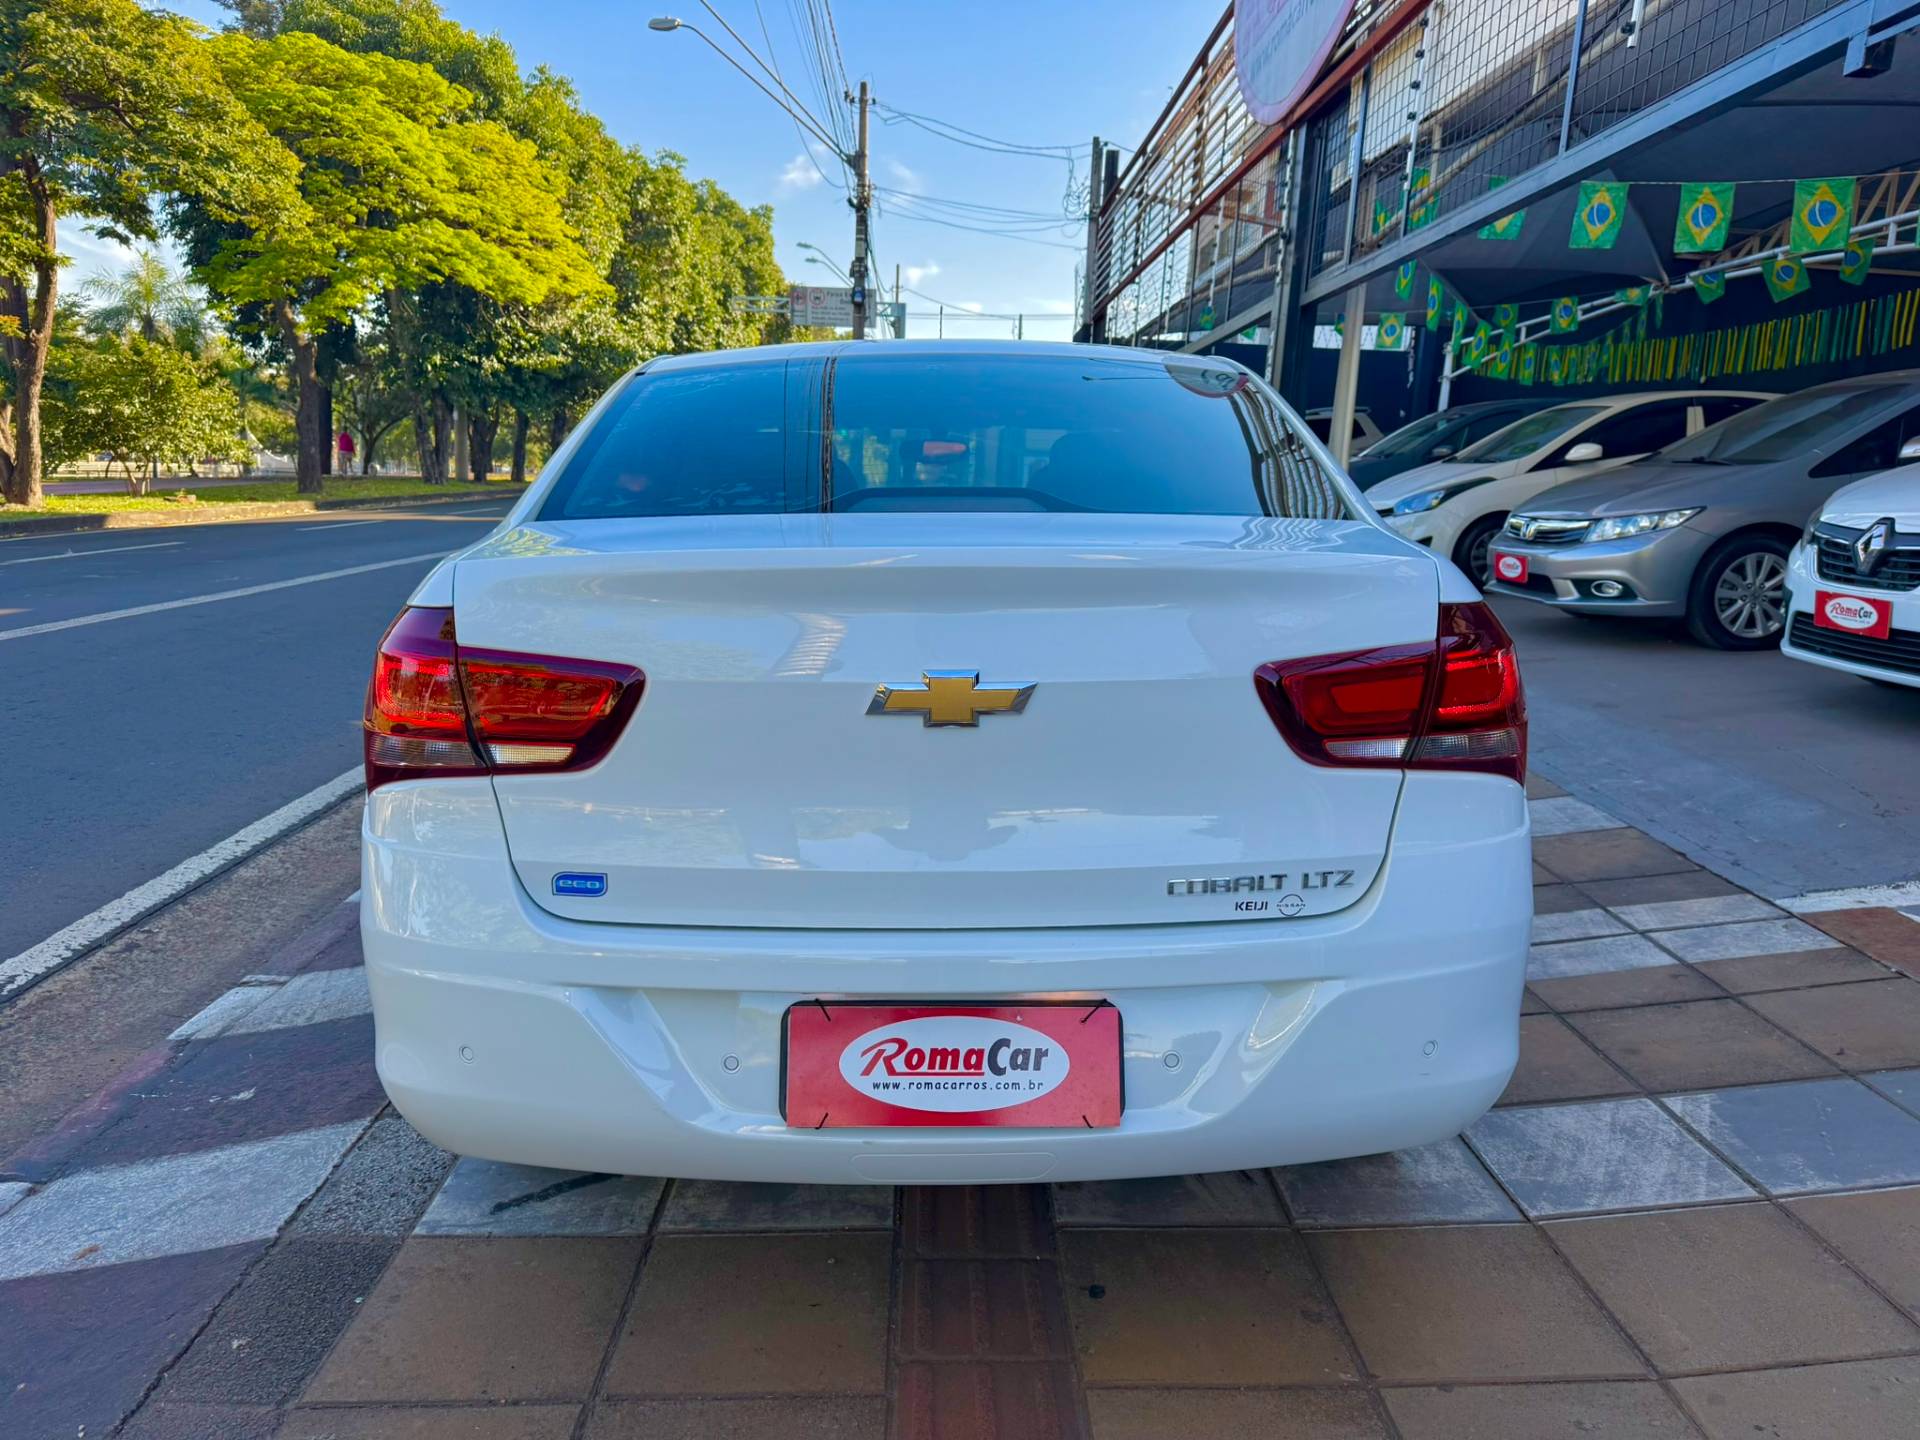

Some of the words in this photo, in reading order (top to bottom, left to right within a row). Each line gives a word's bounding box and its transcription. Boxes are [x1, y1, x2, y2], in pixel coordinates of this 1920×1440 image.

[1830, 602, 1873, 618] RomaCar
[1167, 874, 1287, 896] COBALT
[1301, 869, 1355, 890] LTZ
[1235, 900, 1268, 911] KEIJI
[860, 1037, 1048, 1077] RomaCar
[872, 1079, 1044, 1091] www.romacarros.com.br
